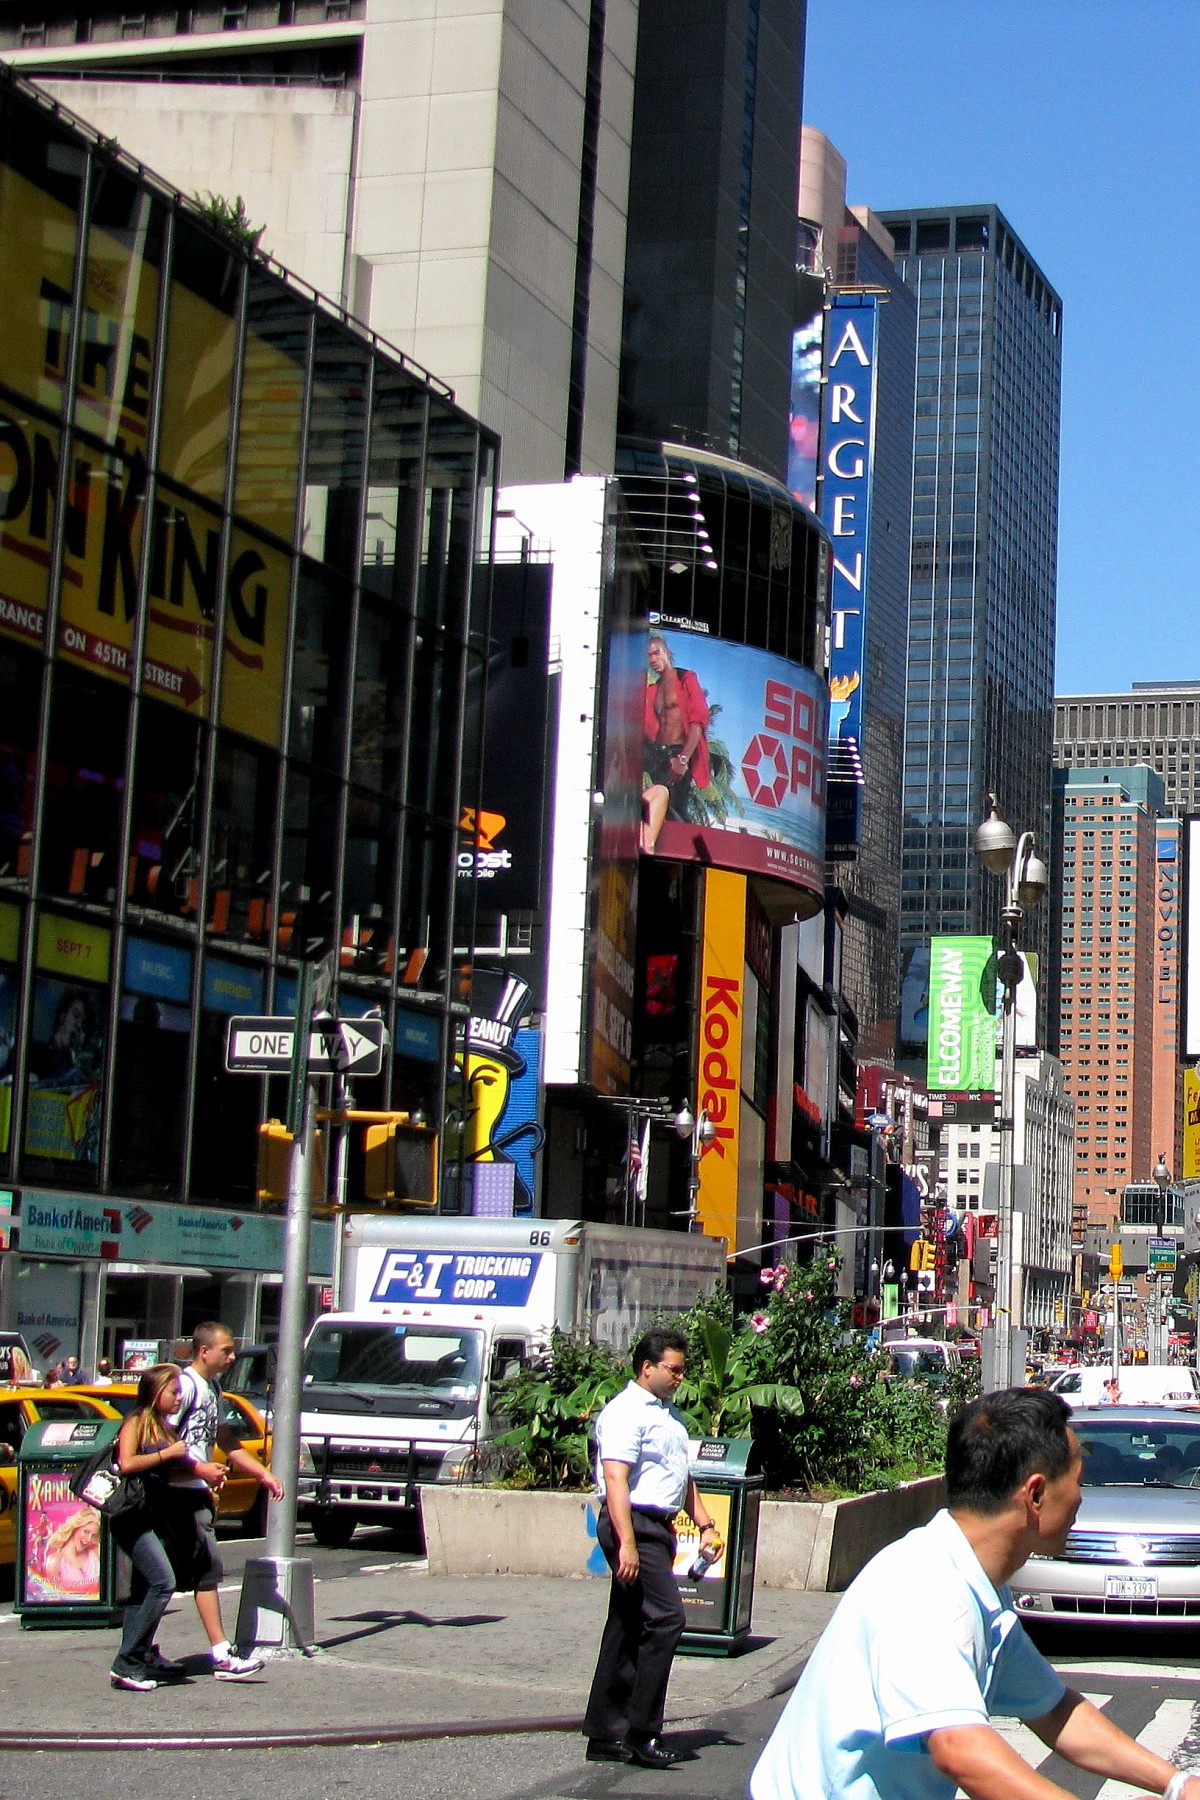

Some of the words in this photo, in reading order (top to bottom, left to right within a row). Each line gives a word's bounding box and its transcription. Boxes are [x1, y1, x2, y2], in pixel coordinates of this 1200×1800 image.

[829, 320, 870, 650] ARGENT
[97, 437, 269, 647] KING
[64, 627, 87, 652] ON
[94, 641, 127, 669] 45TH
[144, 662, 184, 694] STREET
[1158, 865, 1175, 1004] NOVOTEL
[471, 1016, 513, 1047] EANUT
[938, 947, 964, 1086] ELCOMEWAY
[249, 1034, 290, 1055] ONE
[319, 1034, 363, 1057] WAY
[701, 975, 741, 1161] Kodak
[28, 1205, 61, 1228] Bank
[61, 1208, 74, 1229] of
[74, 1207, 111, 1233] Ameri
[529, 1230, 552, 1247] 86
[377, 1252, 454, 1298] F&I
[454, 1256, 533, 1278] TRUCKING
[453, 1278, 498, 1299] CORP.
[1132, 1582, 1153, 1595] 3393
